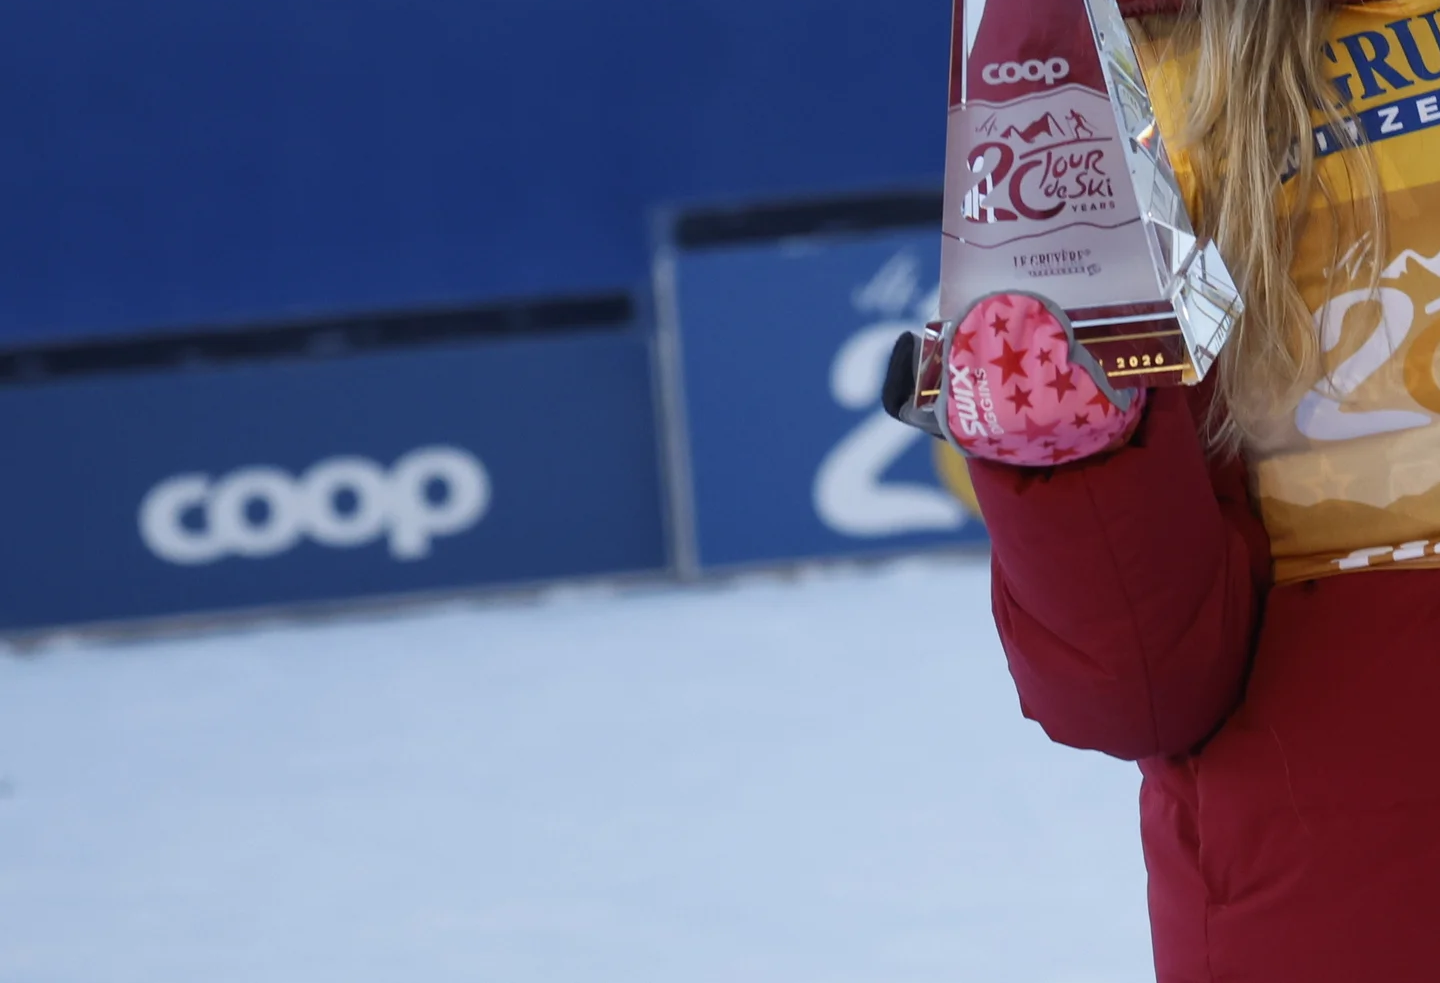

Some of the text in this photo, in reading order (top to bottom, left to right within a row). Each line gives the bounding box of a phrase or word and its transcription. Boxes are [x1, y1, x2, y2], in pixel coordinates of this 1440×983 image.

[982, 57, 1070, 85] coop
[1071, 201, 1116, 213] YEARS
[1116, 352, 1164, 369] 2026
[950, 363, 988, 438] SWIX
[140, 447, 489, 563] coop
